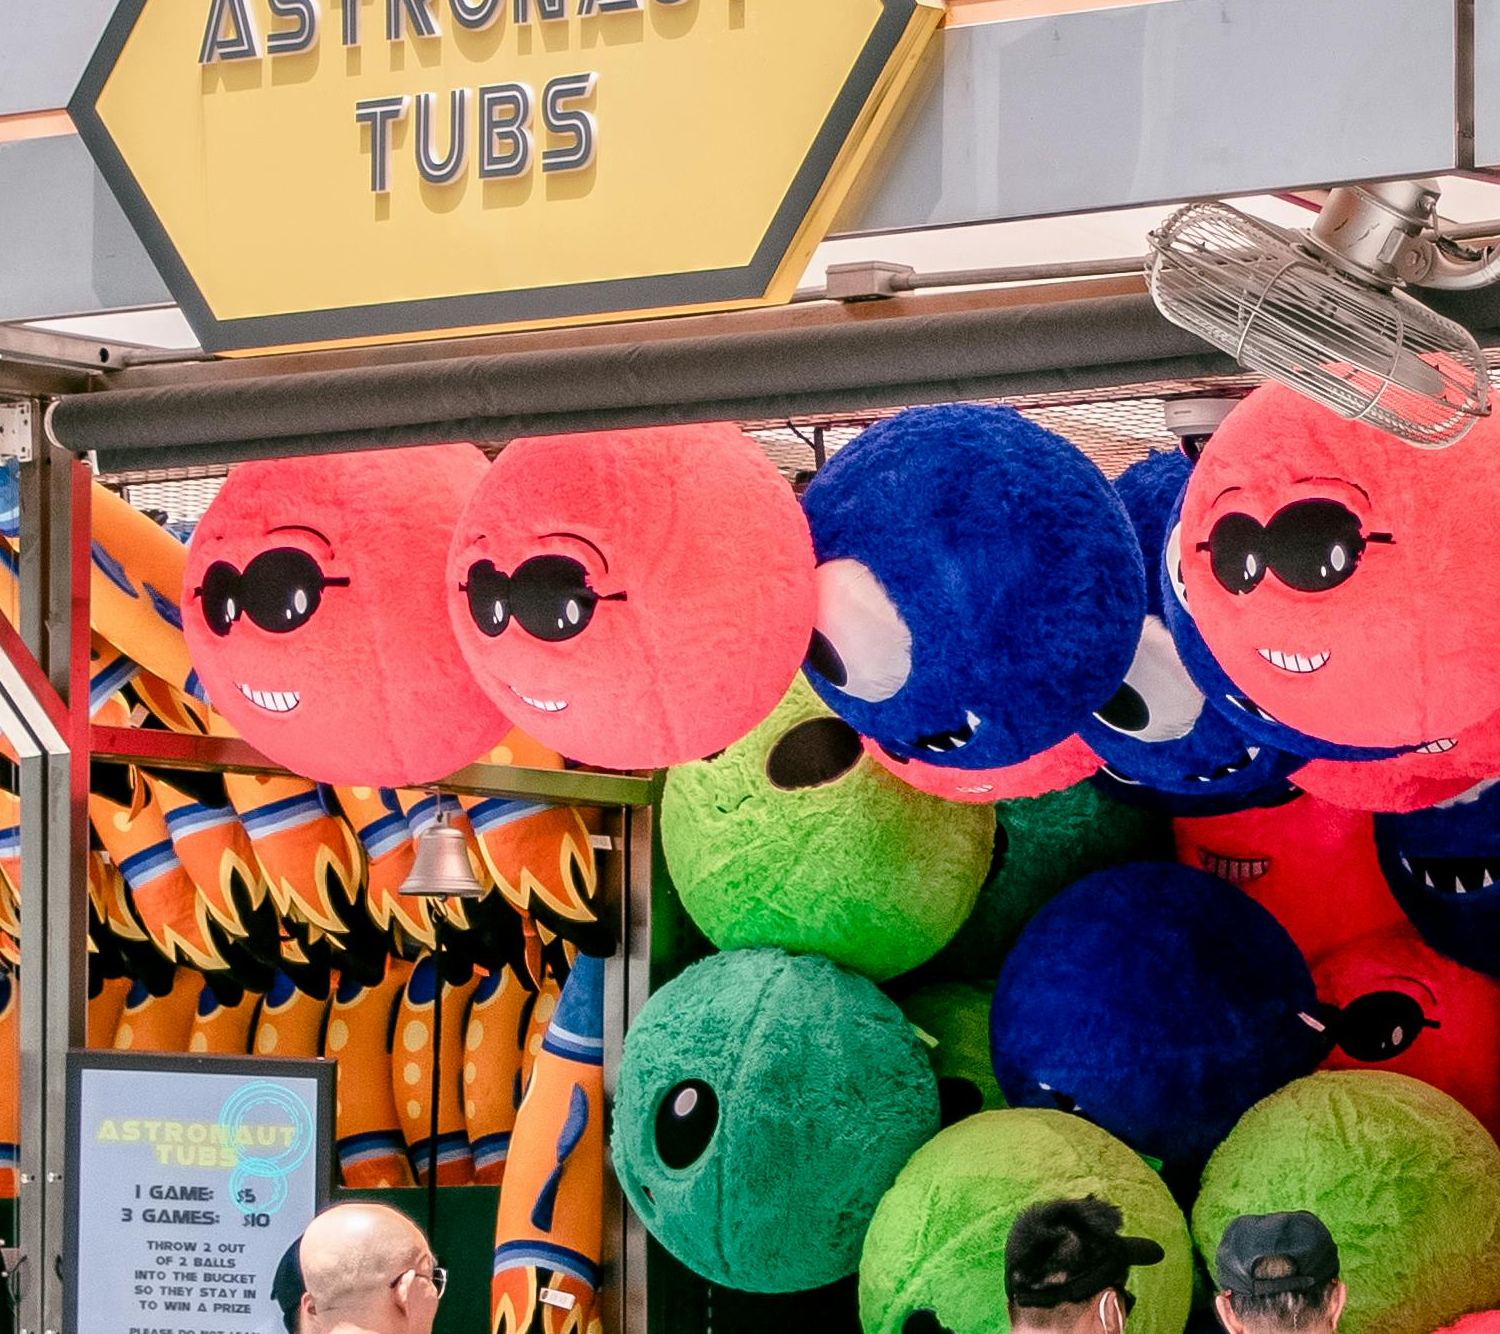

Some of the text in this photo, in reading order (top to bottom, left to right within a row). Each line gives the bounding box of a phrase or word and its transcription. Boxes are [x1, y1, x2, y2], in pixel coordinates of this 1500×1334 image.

[355, 71, 600, 193] TUBS
[98, 1120, 295, 1147] ASTRONAUT
[155, 1144, 237, 1167] TUBS
[149, 1185, 214, 1202] GAME:
[236, 1188, 256, 1205] $5
[121, 1208, 270, 1228] 3 GAMES: $10
[147, 1240, 246, 1254] THROW 2 OUT
[156, 1256, 236, 1268] OF 2 BALLS
[135, 1270, 256, 1284] INTO THE BUCKET
[134, 1285, 256, 1299] SO THEY STAY IN
[139, 1300, 251, 1314] TO WIN A PRIZE
